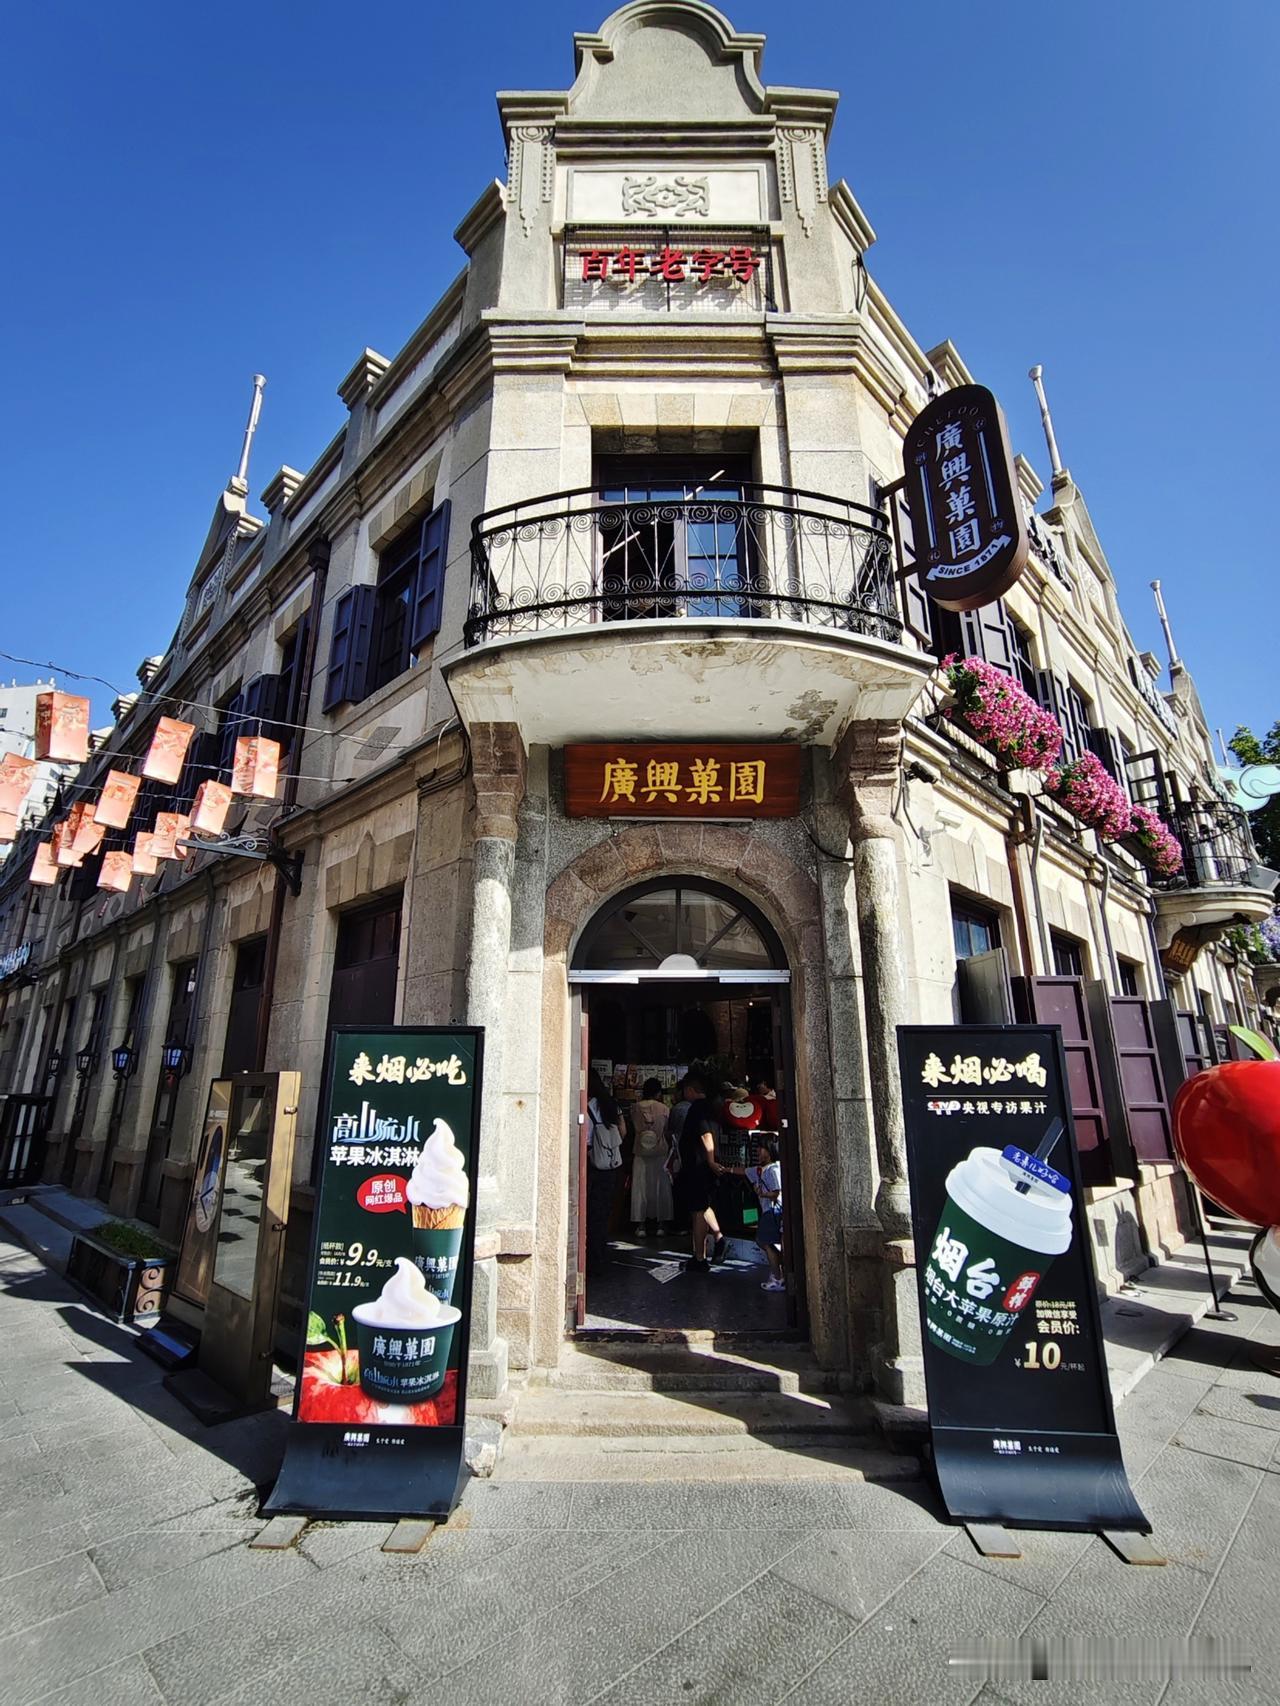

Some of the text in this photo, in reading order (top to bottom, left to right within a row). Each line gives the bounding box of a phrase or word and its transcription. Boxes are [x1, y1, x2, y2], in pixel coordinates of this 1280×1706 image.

[578, 246, 760, 284] 百年老字号
[934, 421, 982, 560] 廣興菓園
[938, 543, 998, 576] SINCE 1871
[599, 757, 767, 805] 廣興菓園
[348, 1051, 467, 1086] 来烟必吃
[921, 1052, 1047, 1088] 来烟必喝
[332, 1101, 421, 1144] 高山流水
[962, 1101, 1047, 1115] 央视专访果汁
[329, 1145, 421, 1167] 苹果冰淇淋
[365, 1192, 403, 1206] 网红爆品
[371, 1179, 397, 1194] 原创
[1036, 1309, 1077, 1319] 加微信享受
[1037, 1320, 1080, 1335] 会员价:
[371, 1335, 436, 1361] 廣興菓園
